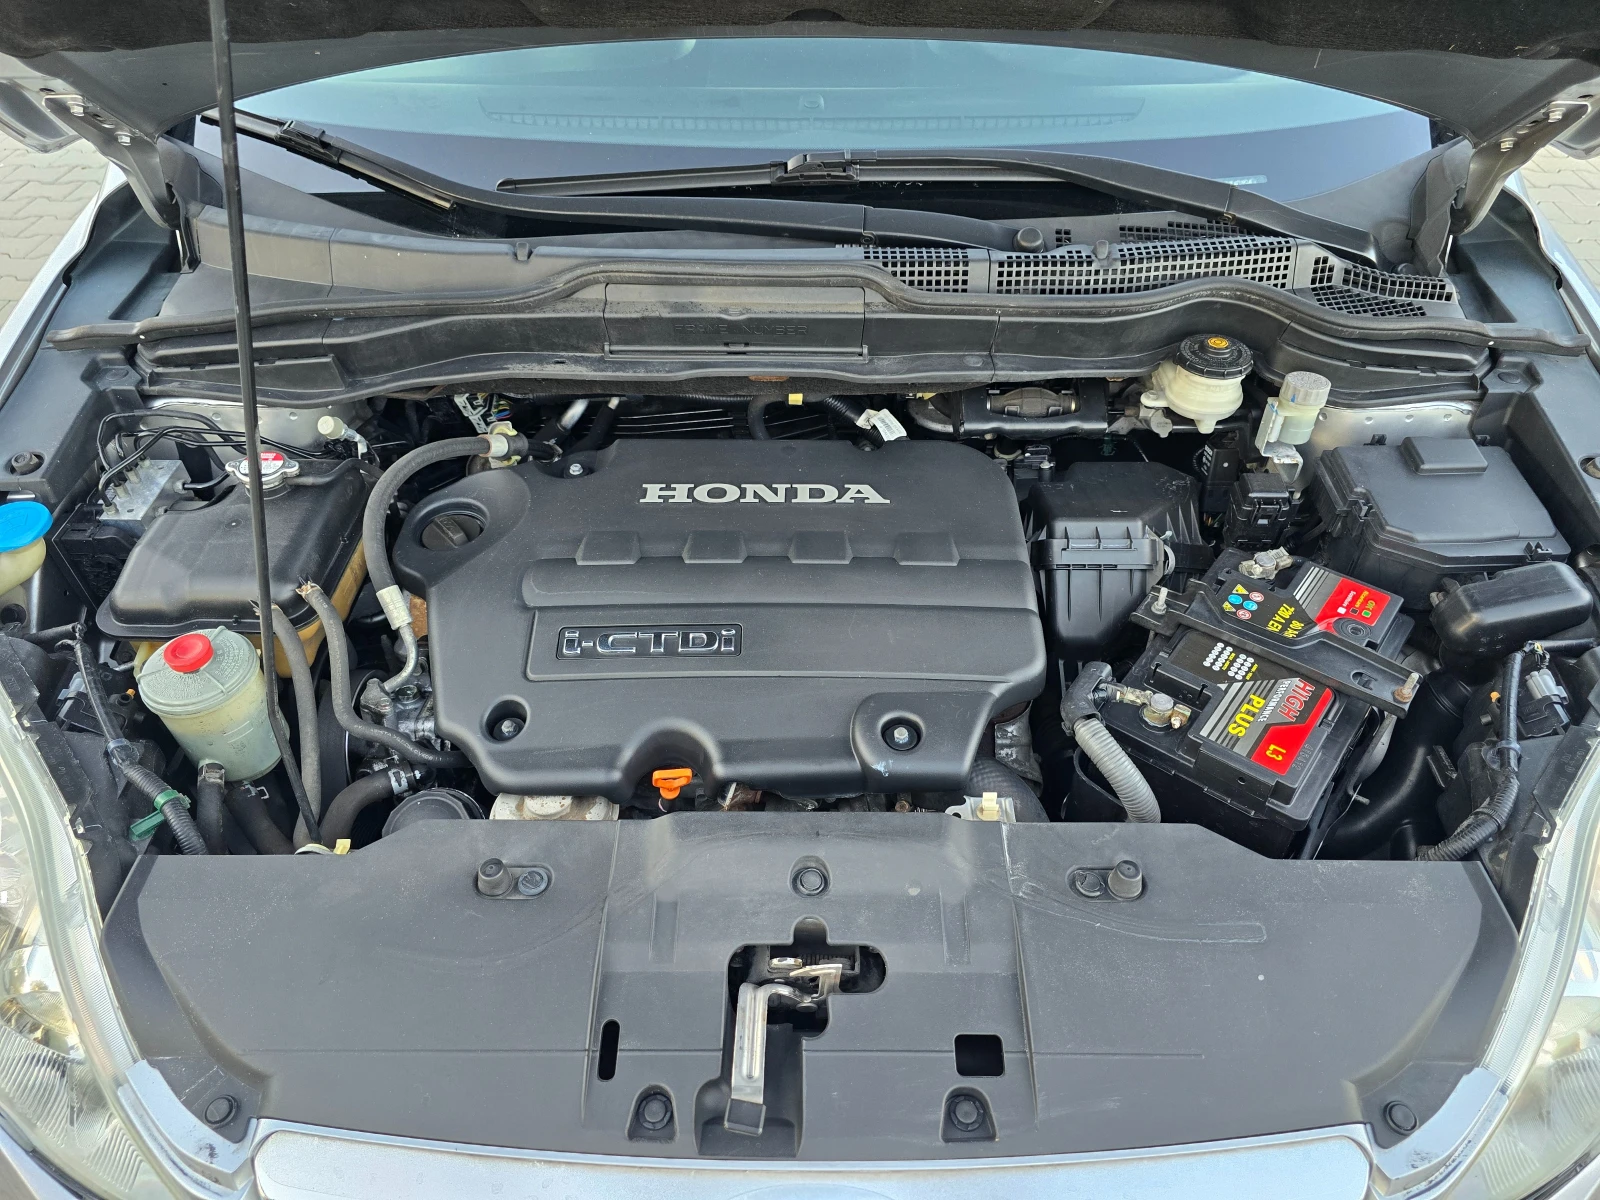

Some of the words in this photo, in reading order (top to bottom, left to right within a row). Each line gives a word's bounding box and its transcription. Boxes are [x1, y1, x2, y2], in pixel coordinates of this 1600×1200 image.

[742, 325, 808, 335] NUMBER
[640, 483, 890, 505] HONDA
[1276, 603, 1295, 619] 720
[563, 628, 736, 654] i-CTDi
[1257, 680, 1292, 723] PERFORMANCE
[1278, 679, 1315, 722] HIGH
[1228, 693, 1267, 738] PLUS
[1266, 744, 1286, 761] L3
